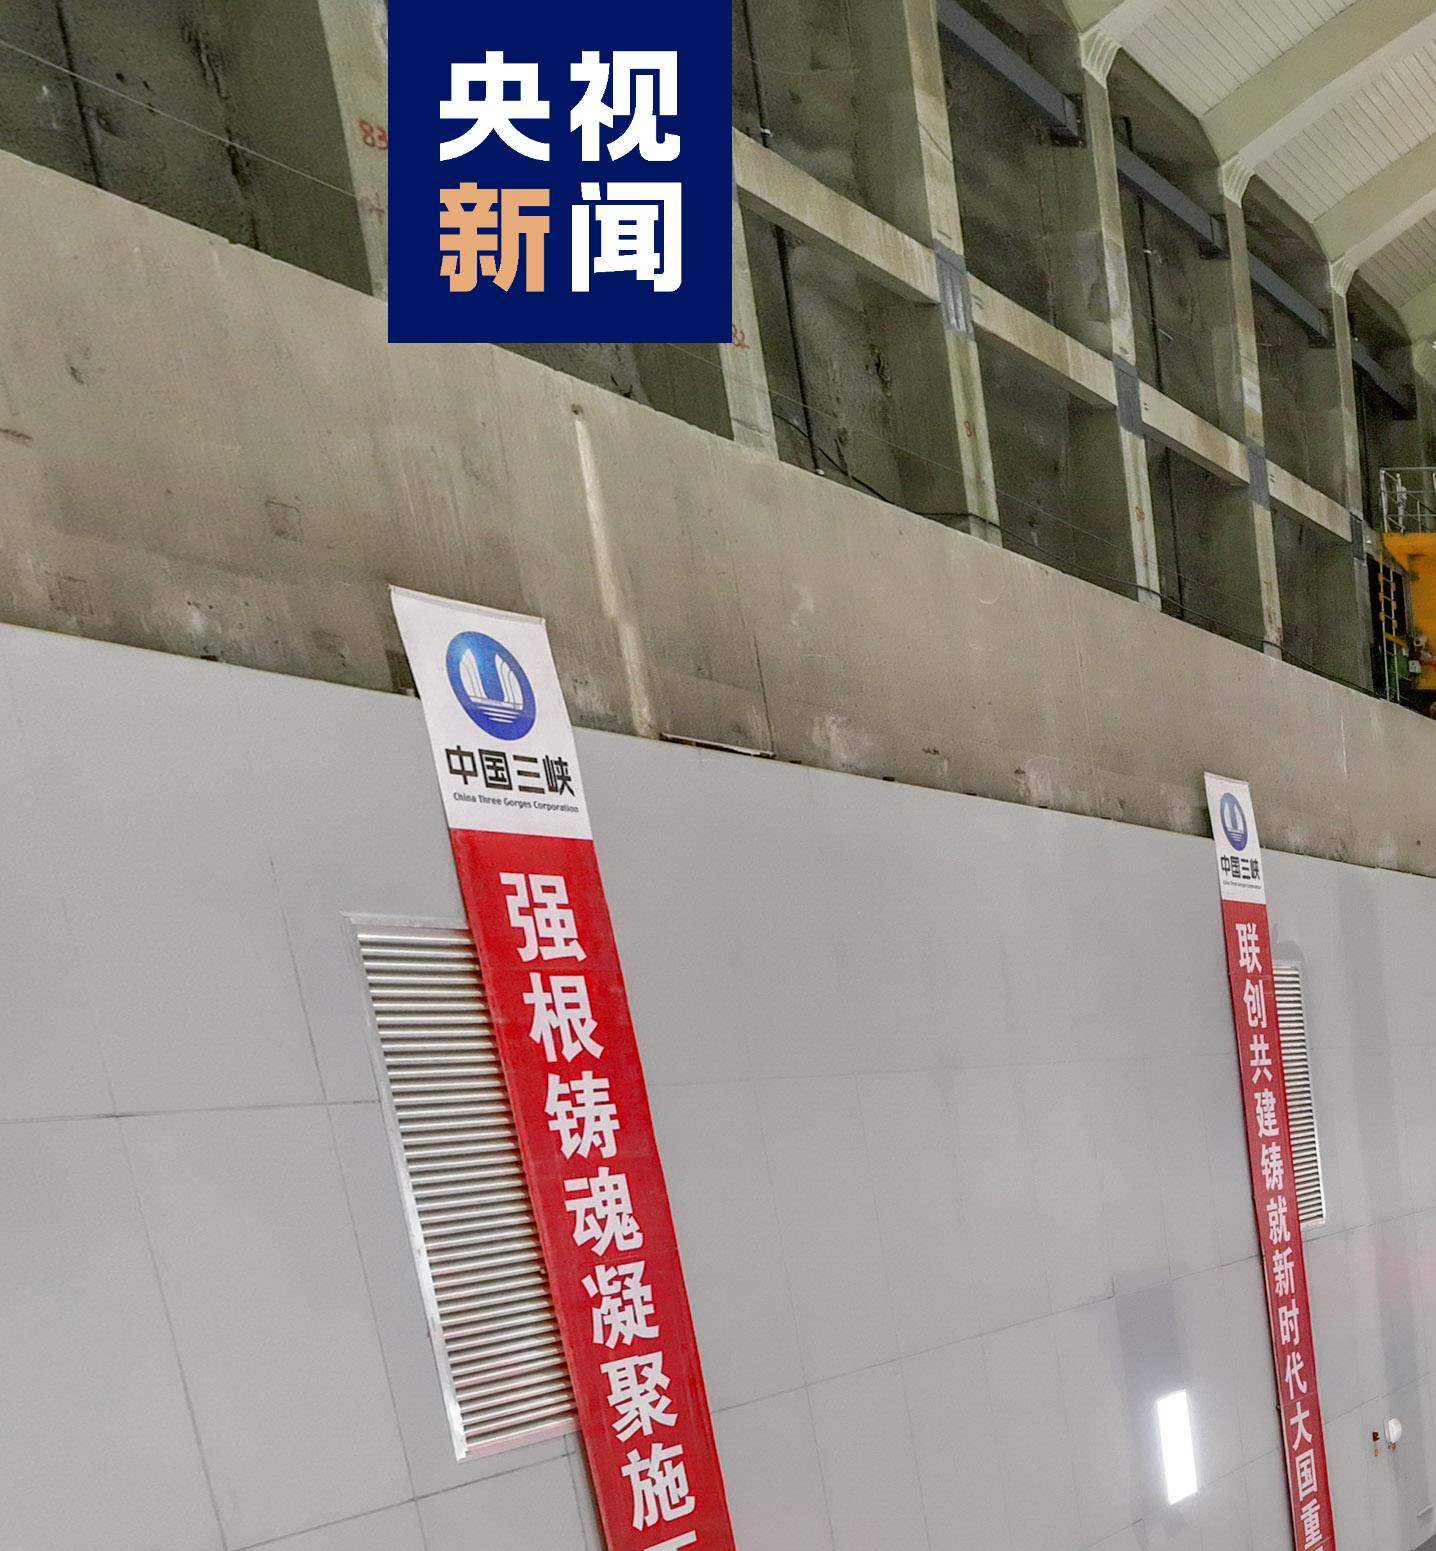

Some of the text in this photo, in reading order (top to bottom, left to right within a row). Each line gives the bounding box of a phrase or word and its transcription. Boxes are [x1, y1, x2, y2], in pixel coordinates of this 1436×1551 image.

[445, 745, 575, 797] 中国三峡
[453, 791, 580, 813] China Three Gorges Corporation
[1221, 854, 1261, 880] 中国三峡
